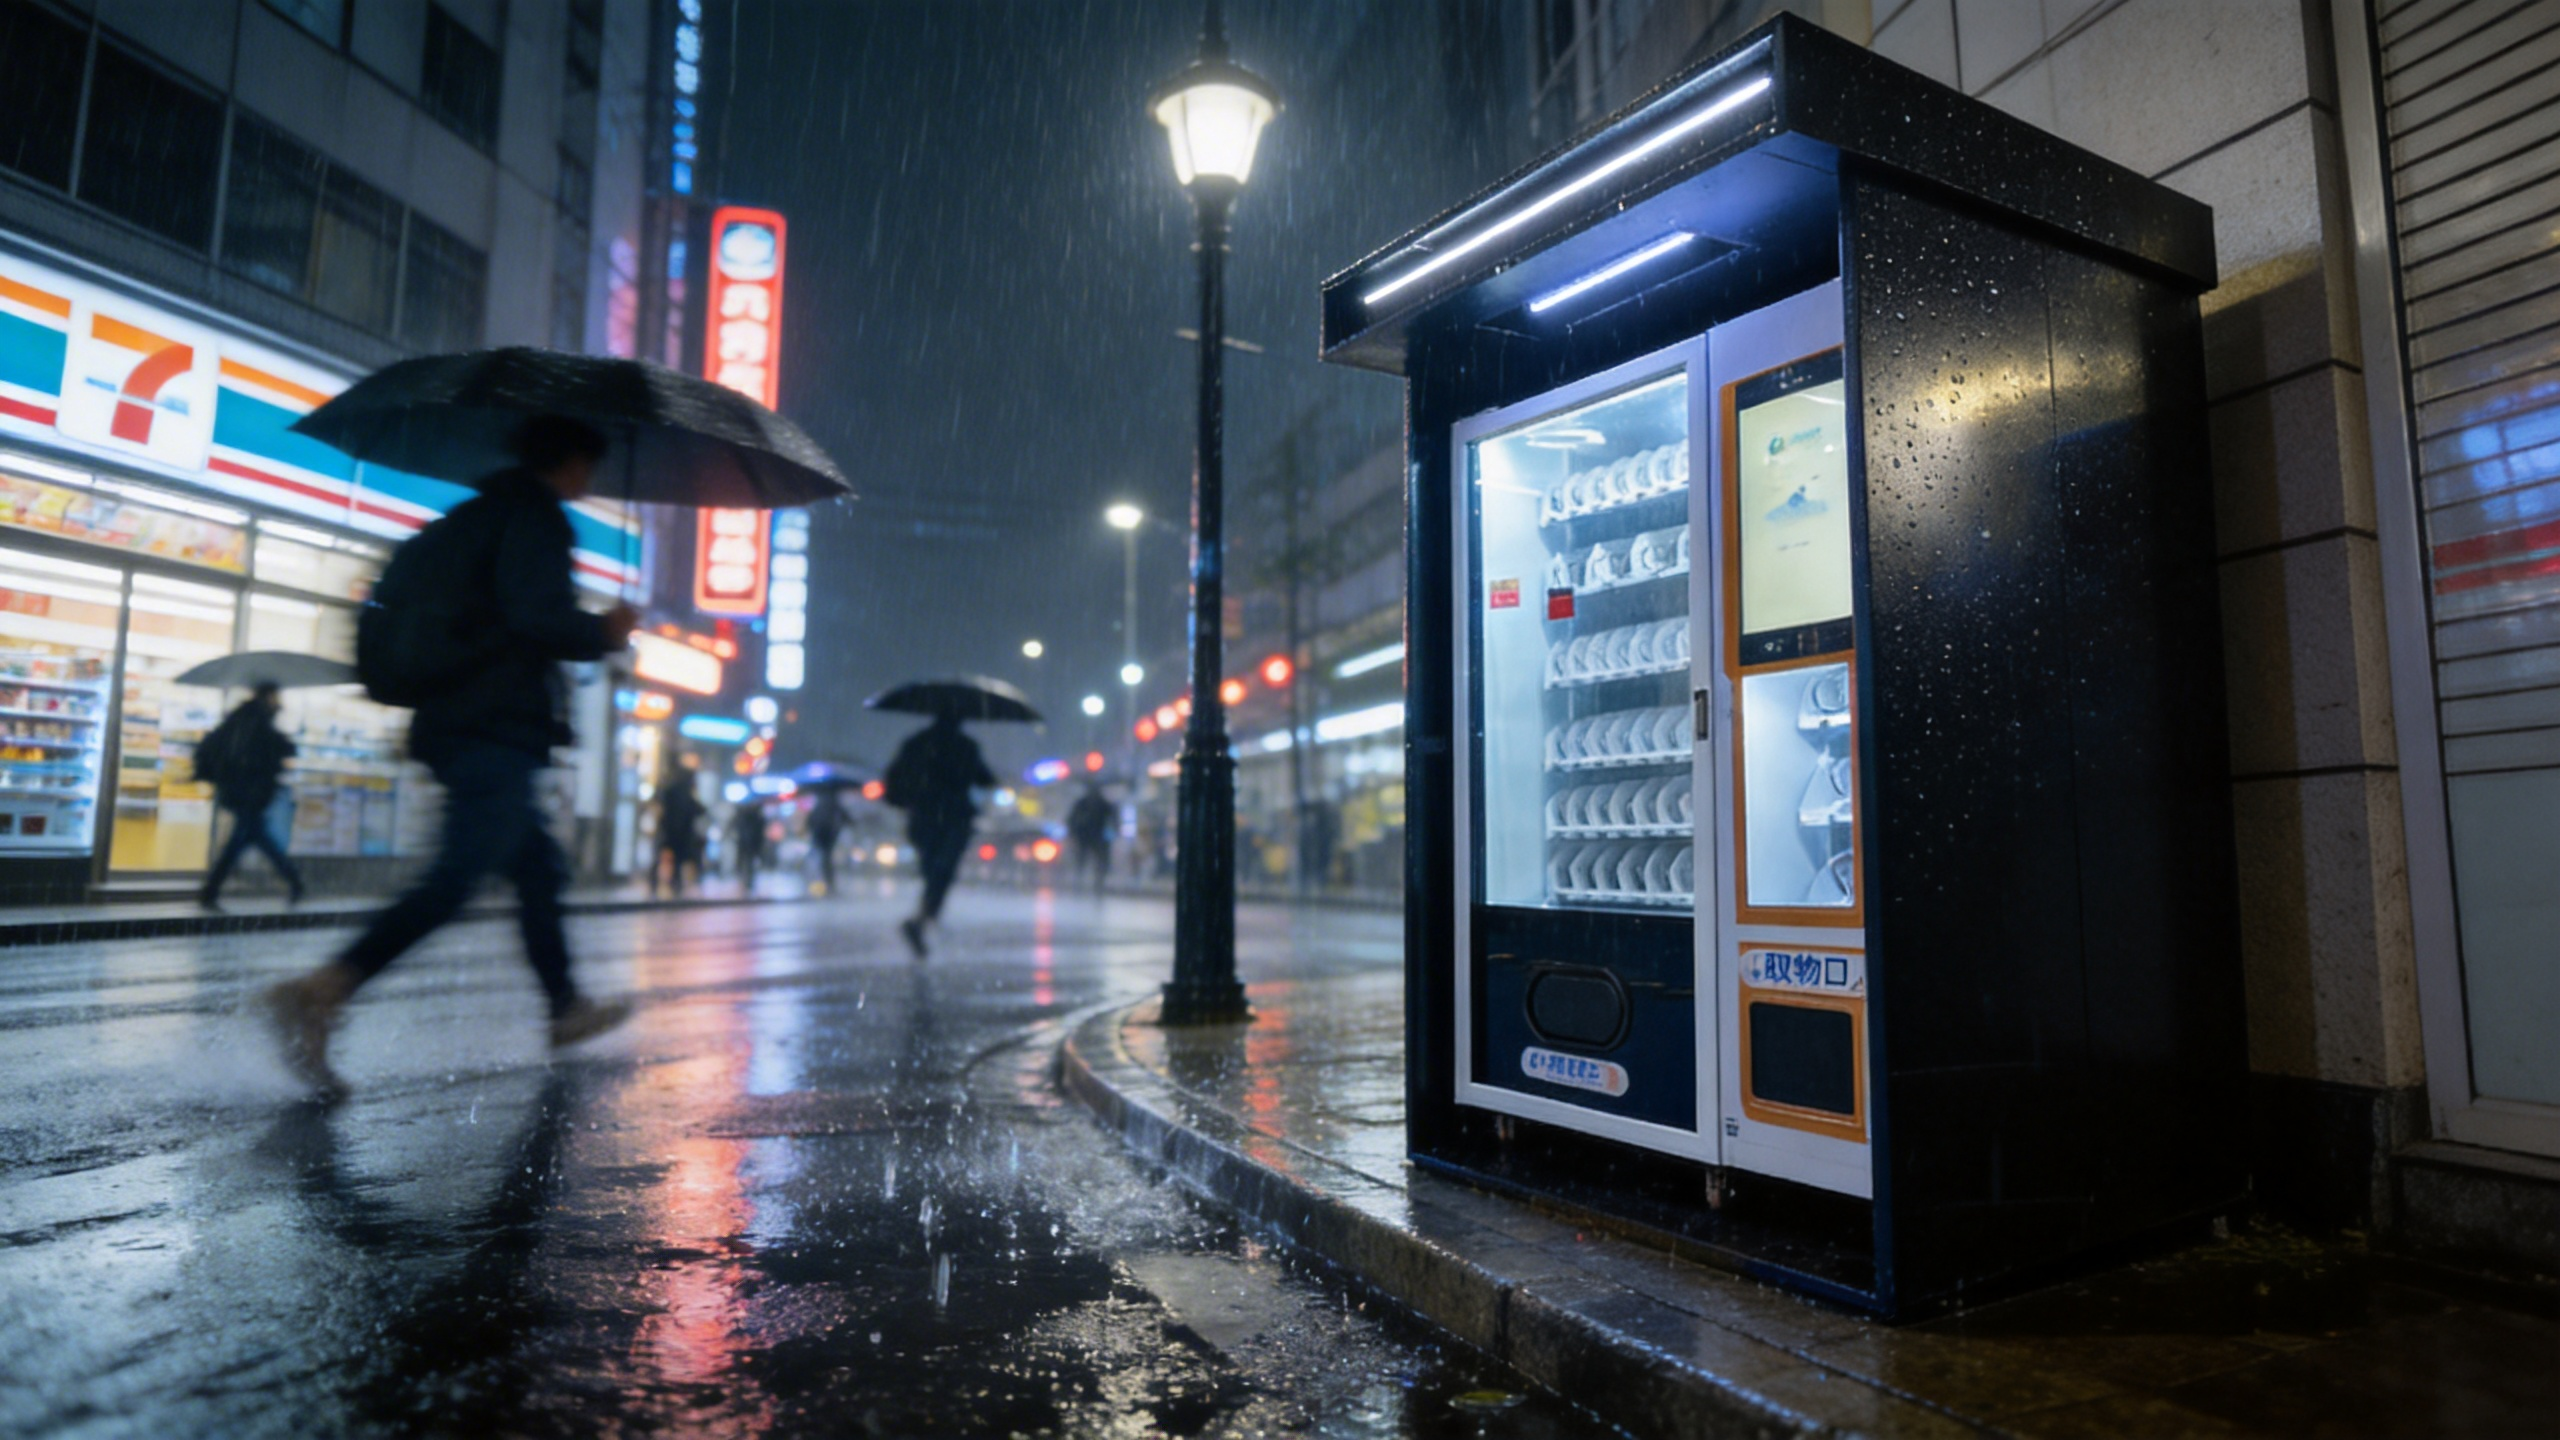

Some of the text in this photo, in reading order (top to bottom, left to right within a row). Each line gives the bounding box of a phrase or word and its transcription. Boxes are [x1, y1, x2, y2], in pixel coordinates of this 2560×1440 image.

[91, 312, 194, 445] 7
[1764, 952, 1848, 986] 取物口
